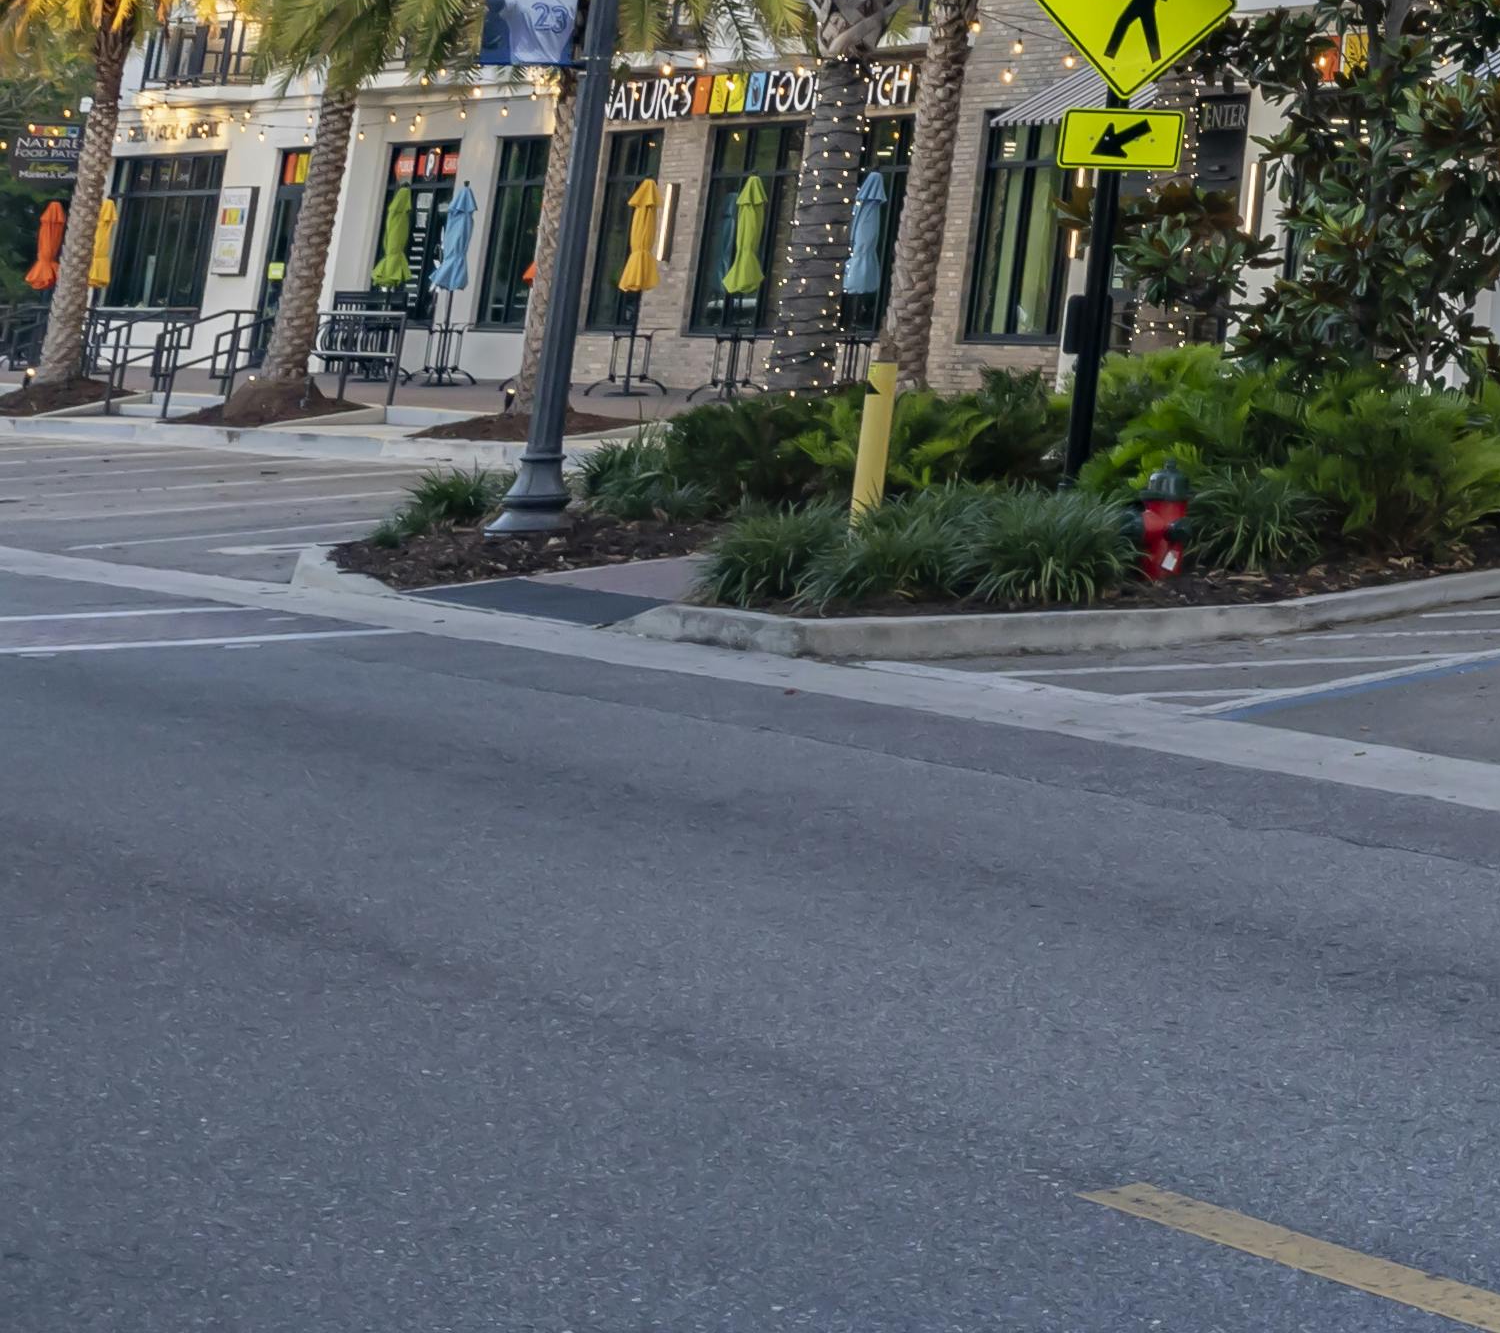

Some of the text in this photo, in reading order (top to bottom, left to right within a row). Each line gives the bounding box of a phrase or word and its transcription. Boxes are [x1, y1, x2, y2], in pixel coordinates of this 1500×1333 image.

[532, 2, 568, 34] 23
[765, 70, 818, 112] FOO
[1204, 104, 1246, 129] ENTER
[15, 149, 80, 158] FOOD PATC
[17, 137, 83, 149] NATURE'
